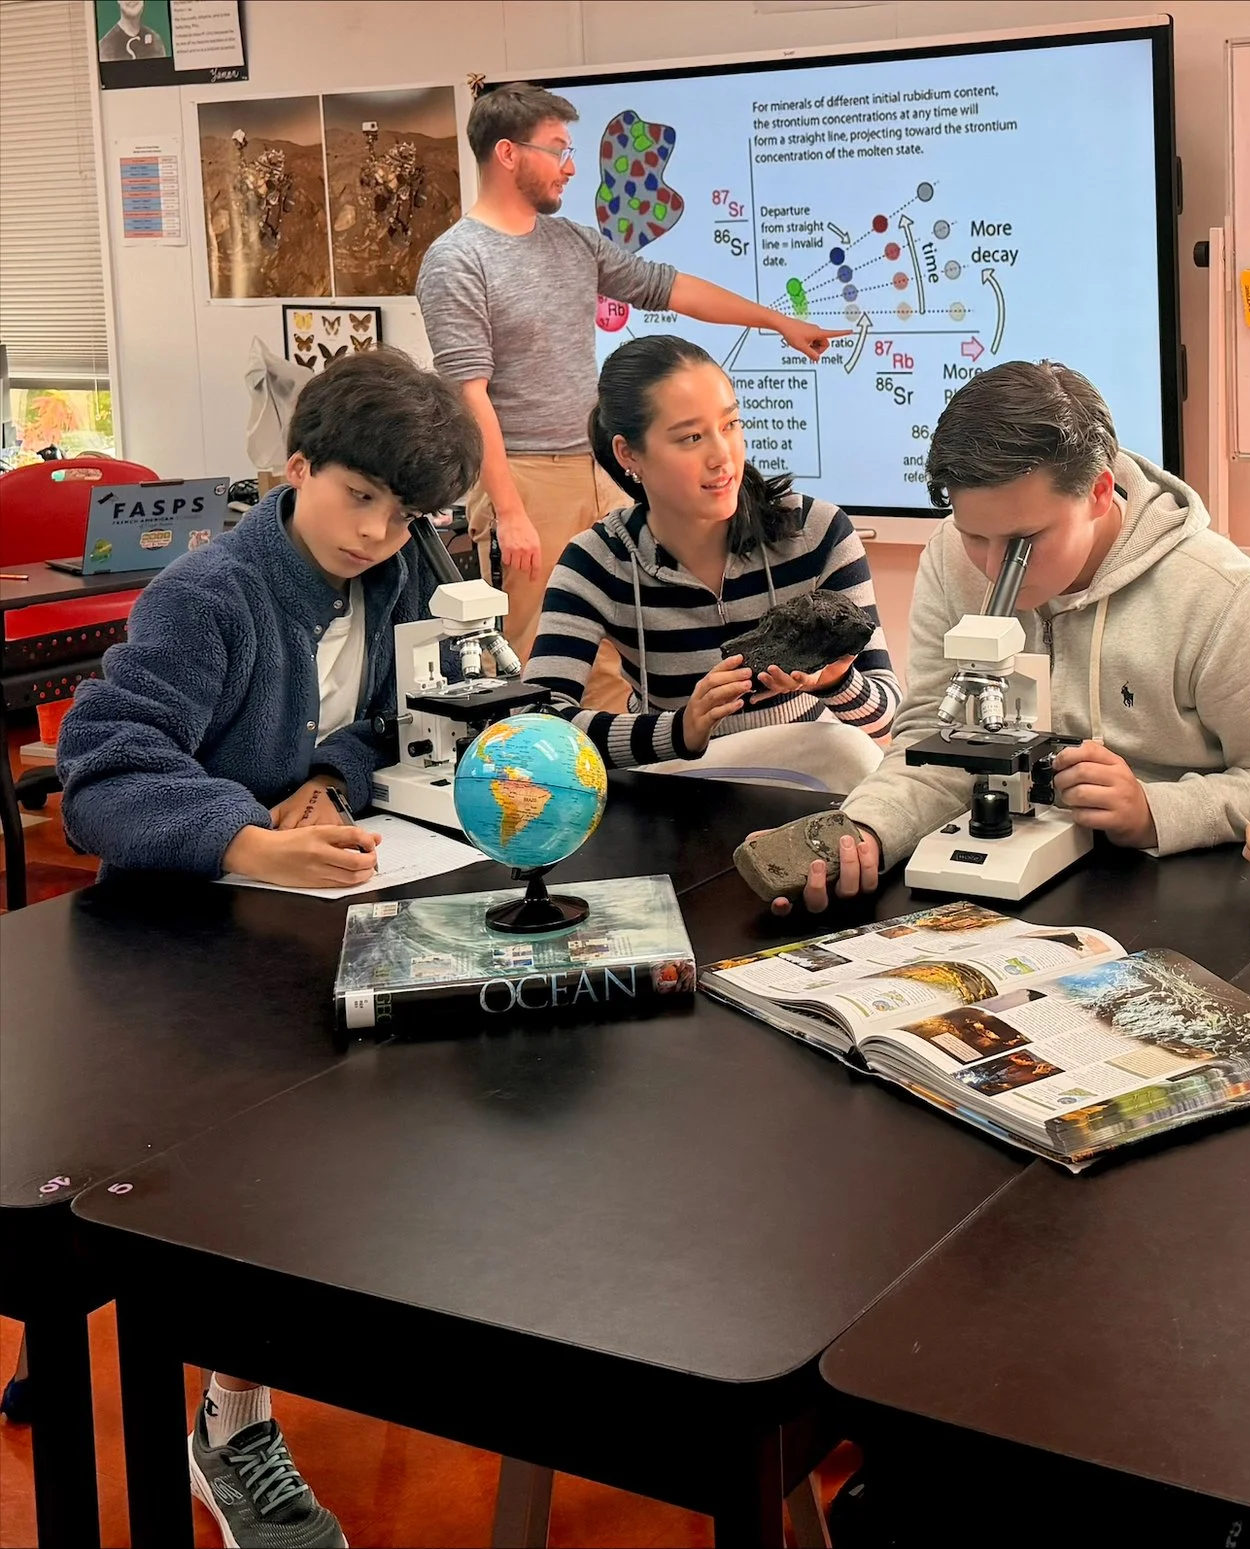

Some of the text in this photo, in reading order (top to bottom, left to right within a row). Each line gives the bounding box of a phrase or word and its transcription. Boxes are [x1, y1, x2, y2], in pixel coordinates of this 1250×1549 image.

[753, 85, 999, 113] For minerals of different initial rubidium content,
[753, 103, 979, 130] the strontium concentrations at any time will
[754, 120, 1018, 147] form a straight line, projecting toward the strontium
[755, 144, 924, 164] concentration of the molten state.
[760, 205, 811, 219] Departure
[761, 220, 824, 236] from straight
[971, 220, 1012, 237] More
[762, 238, 780, 250] line
[762, 256, 787, 267] date.
[922, 242, 939, 283] time
[971, 247, 1019, 267] decay
[608, 302, 626, 317] Rb
[599, 318, 610, 328] 37
[644, 313, 678, 323] 272 keV
[831, 337, 855, 349] ratio
[781, 355, 807, 365] same
[821, 353, 844, 365] melt
[732, 375, 808, 390] ime after the
[743, 395, 794, 411] isochron
[772, 418, 784, 430] to
[787, 416, 807, 431] the
[751, 436, 779, 451] ratio
[781, 438, 793, 451] at
[758, 457, 789, 471] melt.
[903, 454, 924, 466] and
[113, 496, 205, 519] FASPS
[479, 965, 637, 1014] OCEAN
